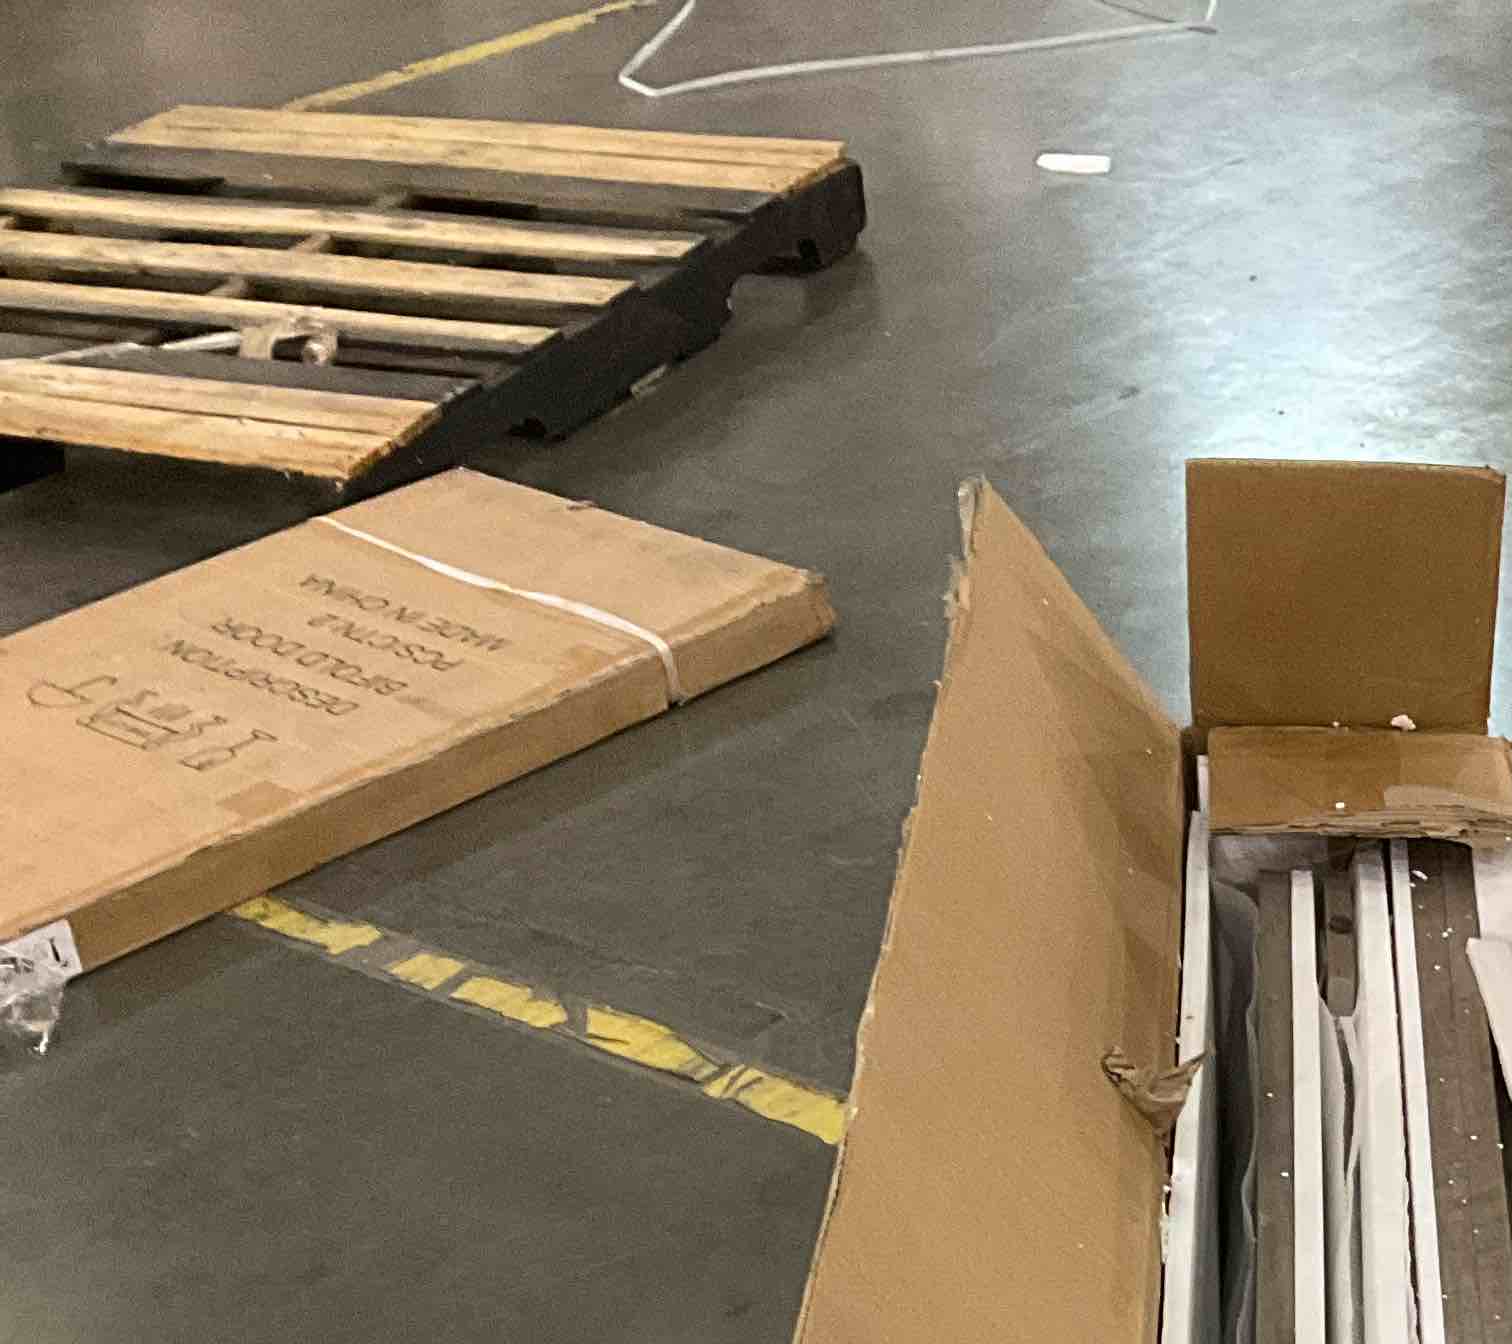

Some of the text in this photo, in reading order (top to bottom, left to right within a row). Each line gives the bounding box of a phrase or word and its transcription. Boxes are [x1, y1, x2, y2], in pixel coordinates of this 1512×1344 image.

[299, 574, 513, 653] MADE IN CHINA
[209, 617, 408, 697] BIFOLD DOOR
